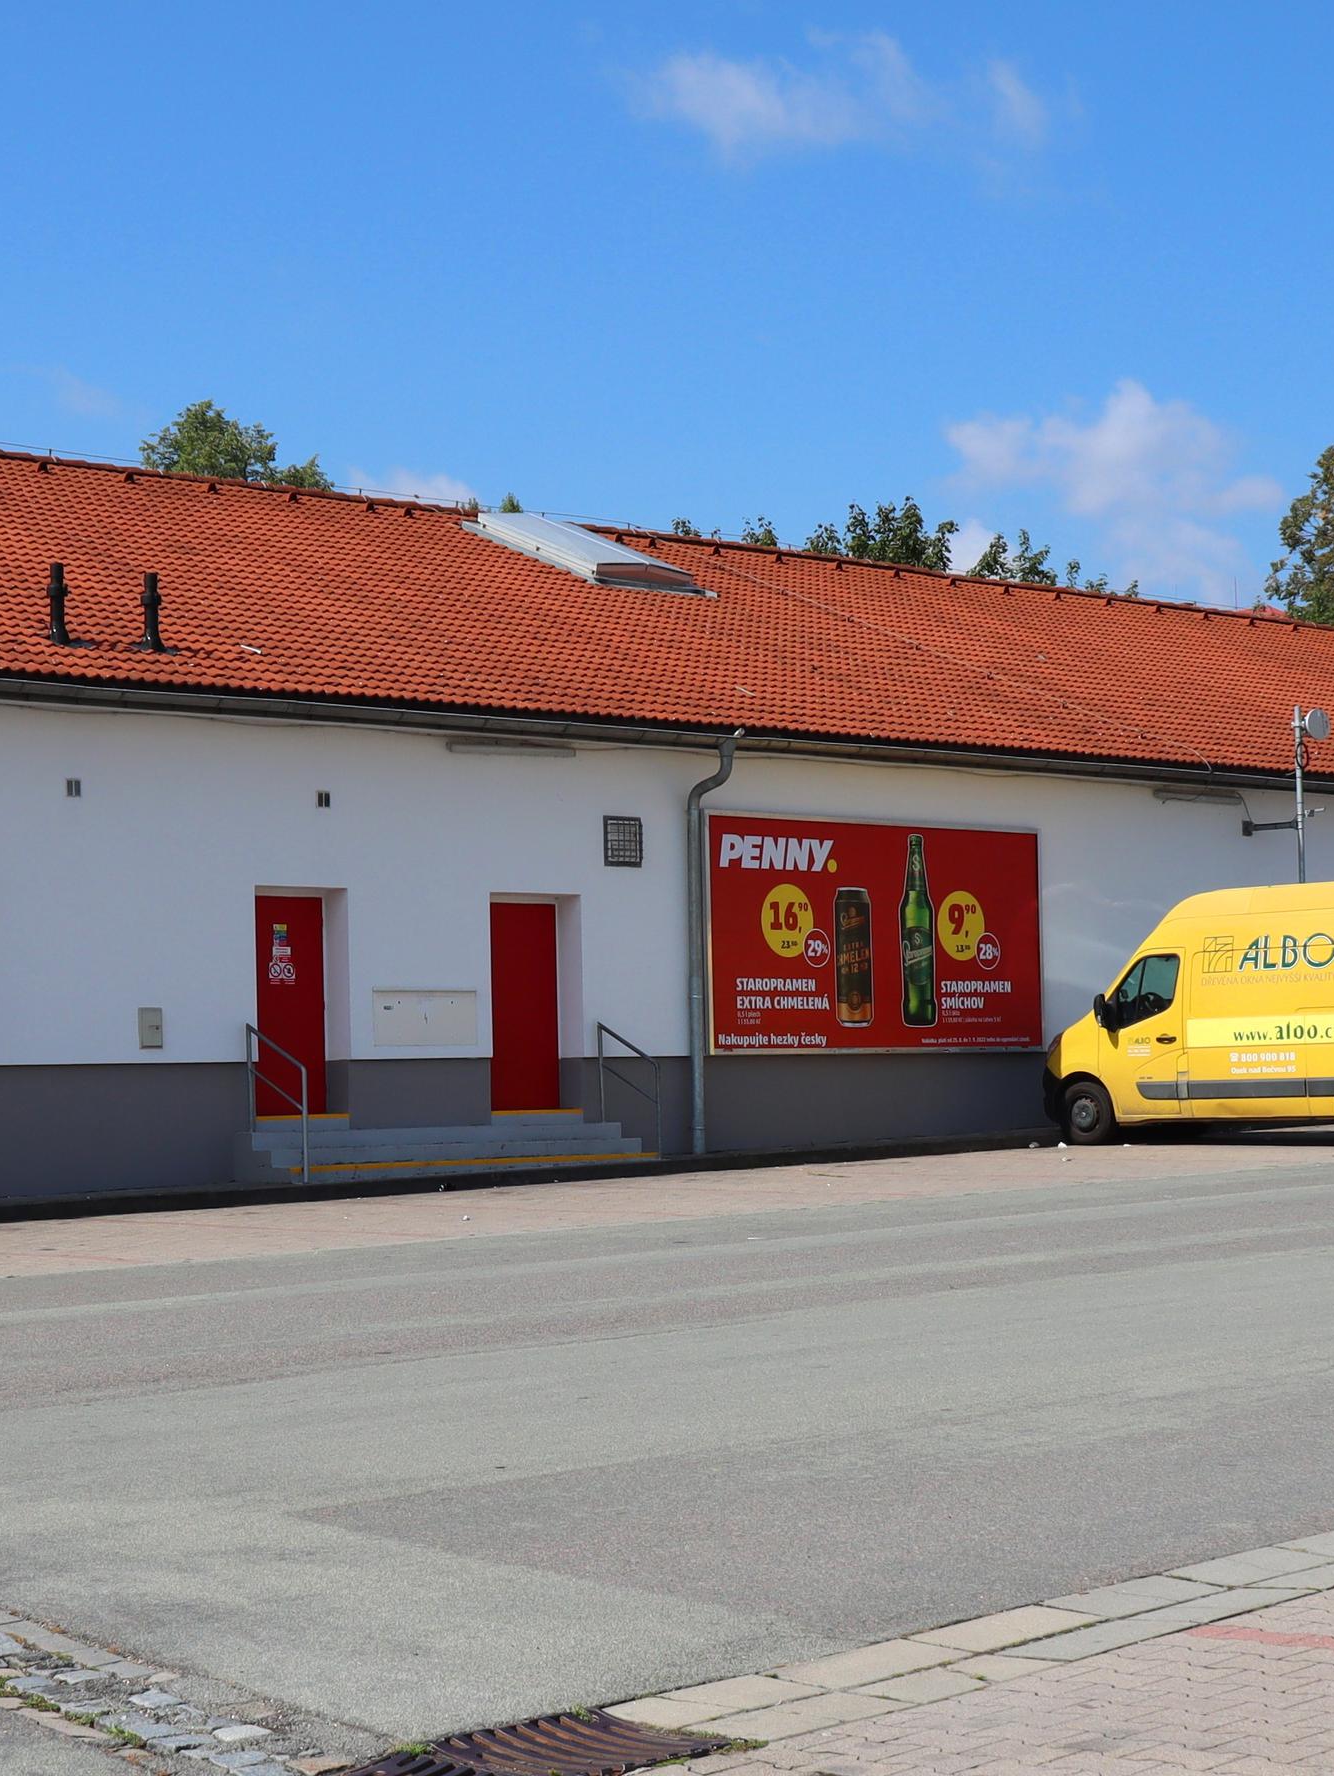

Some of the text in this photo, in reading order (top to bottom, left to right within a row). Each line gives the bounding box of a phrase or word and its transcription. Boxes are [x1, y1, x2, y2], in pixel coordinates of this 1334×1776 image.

[807, 939, 828, 957] 29%
[979, 943, 999, 960] 28%
[736, 977, 816, 992] STAROPRAMEN
[1240, 974, 1264, 984] OKNA
[941, 981, 1011, 993] STAROPRAMEN
[736, 993, 830, 1010] EXTRA CHMELENÁ
[941, 993, 984, 1009] SMÍCHOV
[718, 1032, 827, 1047] Nakupujte hezky česky
[1241, 1053, 1257, 1062] 800
[1260, 1052, 1277, 1062] 900
